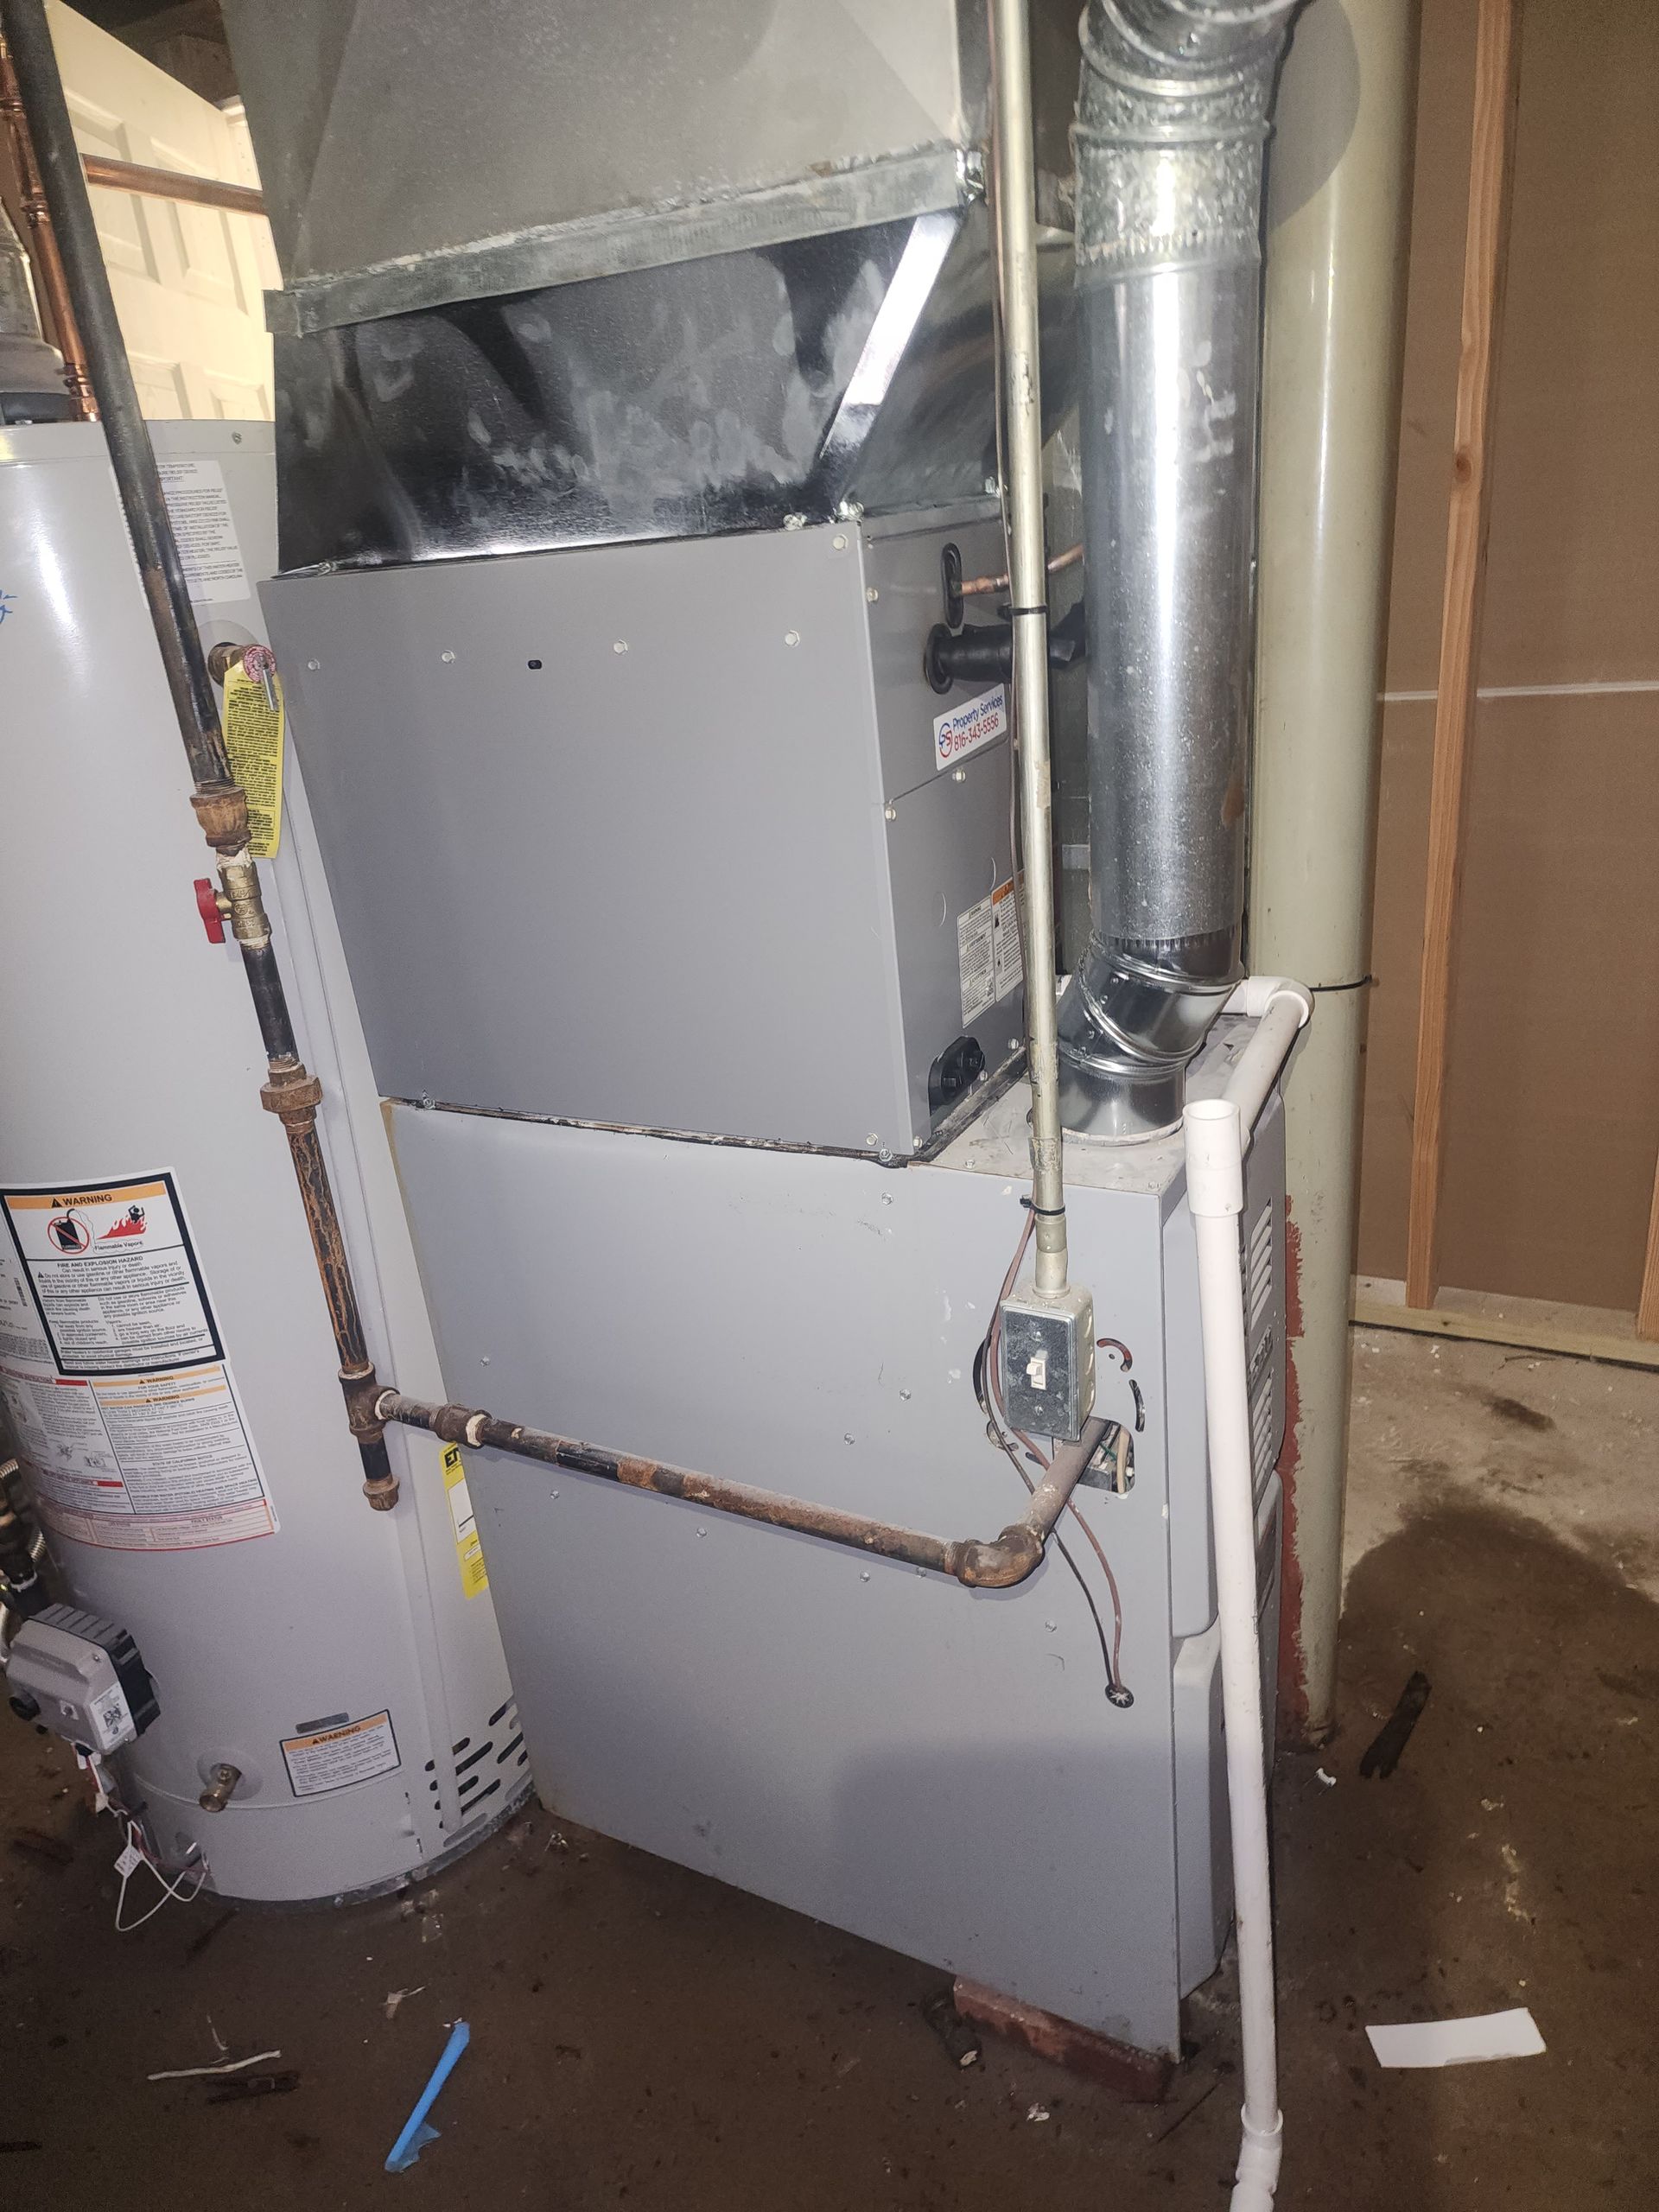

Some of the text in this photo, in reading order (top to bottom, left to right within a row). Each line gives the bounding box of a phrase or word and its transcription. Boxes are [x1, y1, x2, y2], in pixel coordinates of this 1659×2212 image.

[953, 695, 1002, 731] Property Services
[954, 712, 999, 751] 816-343-5556
[62, 1194, 112, 1206] WARNING
[320, 1726, 361, 1742] WARNING
